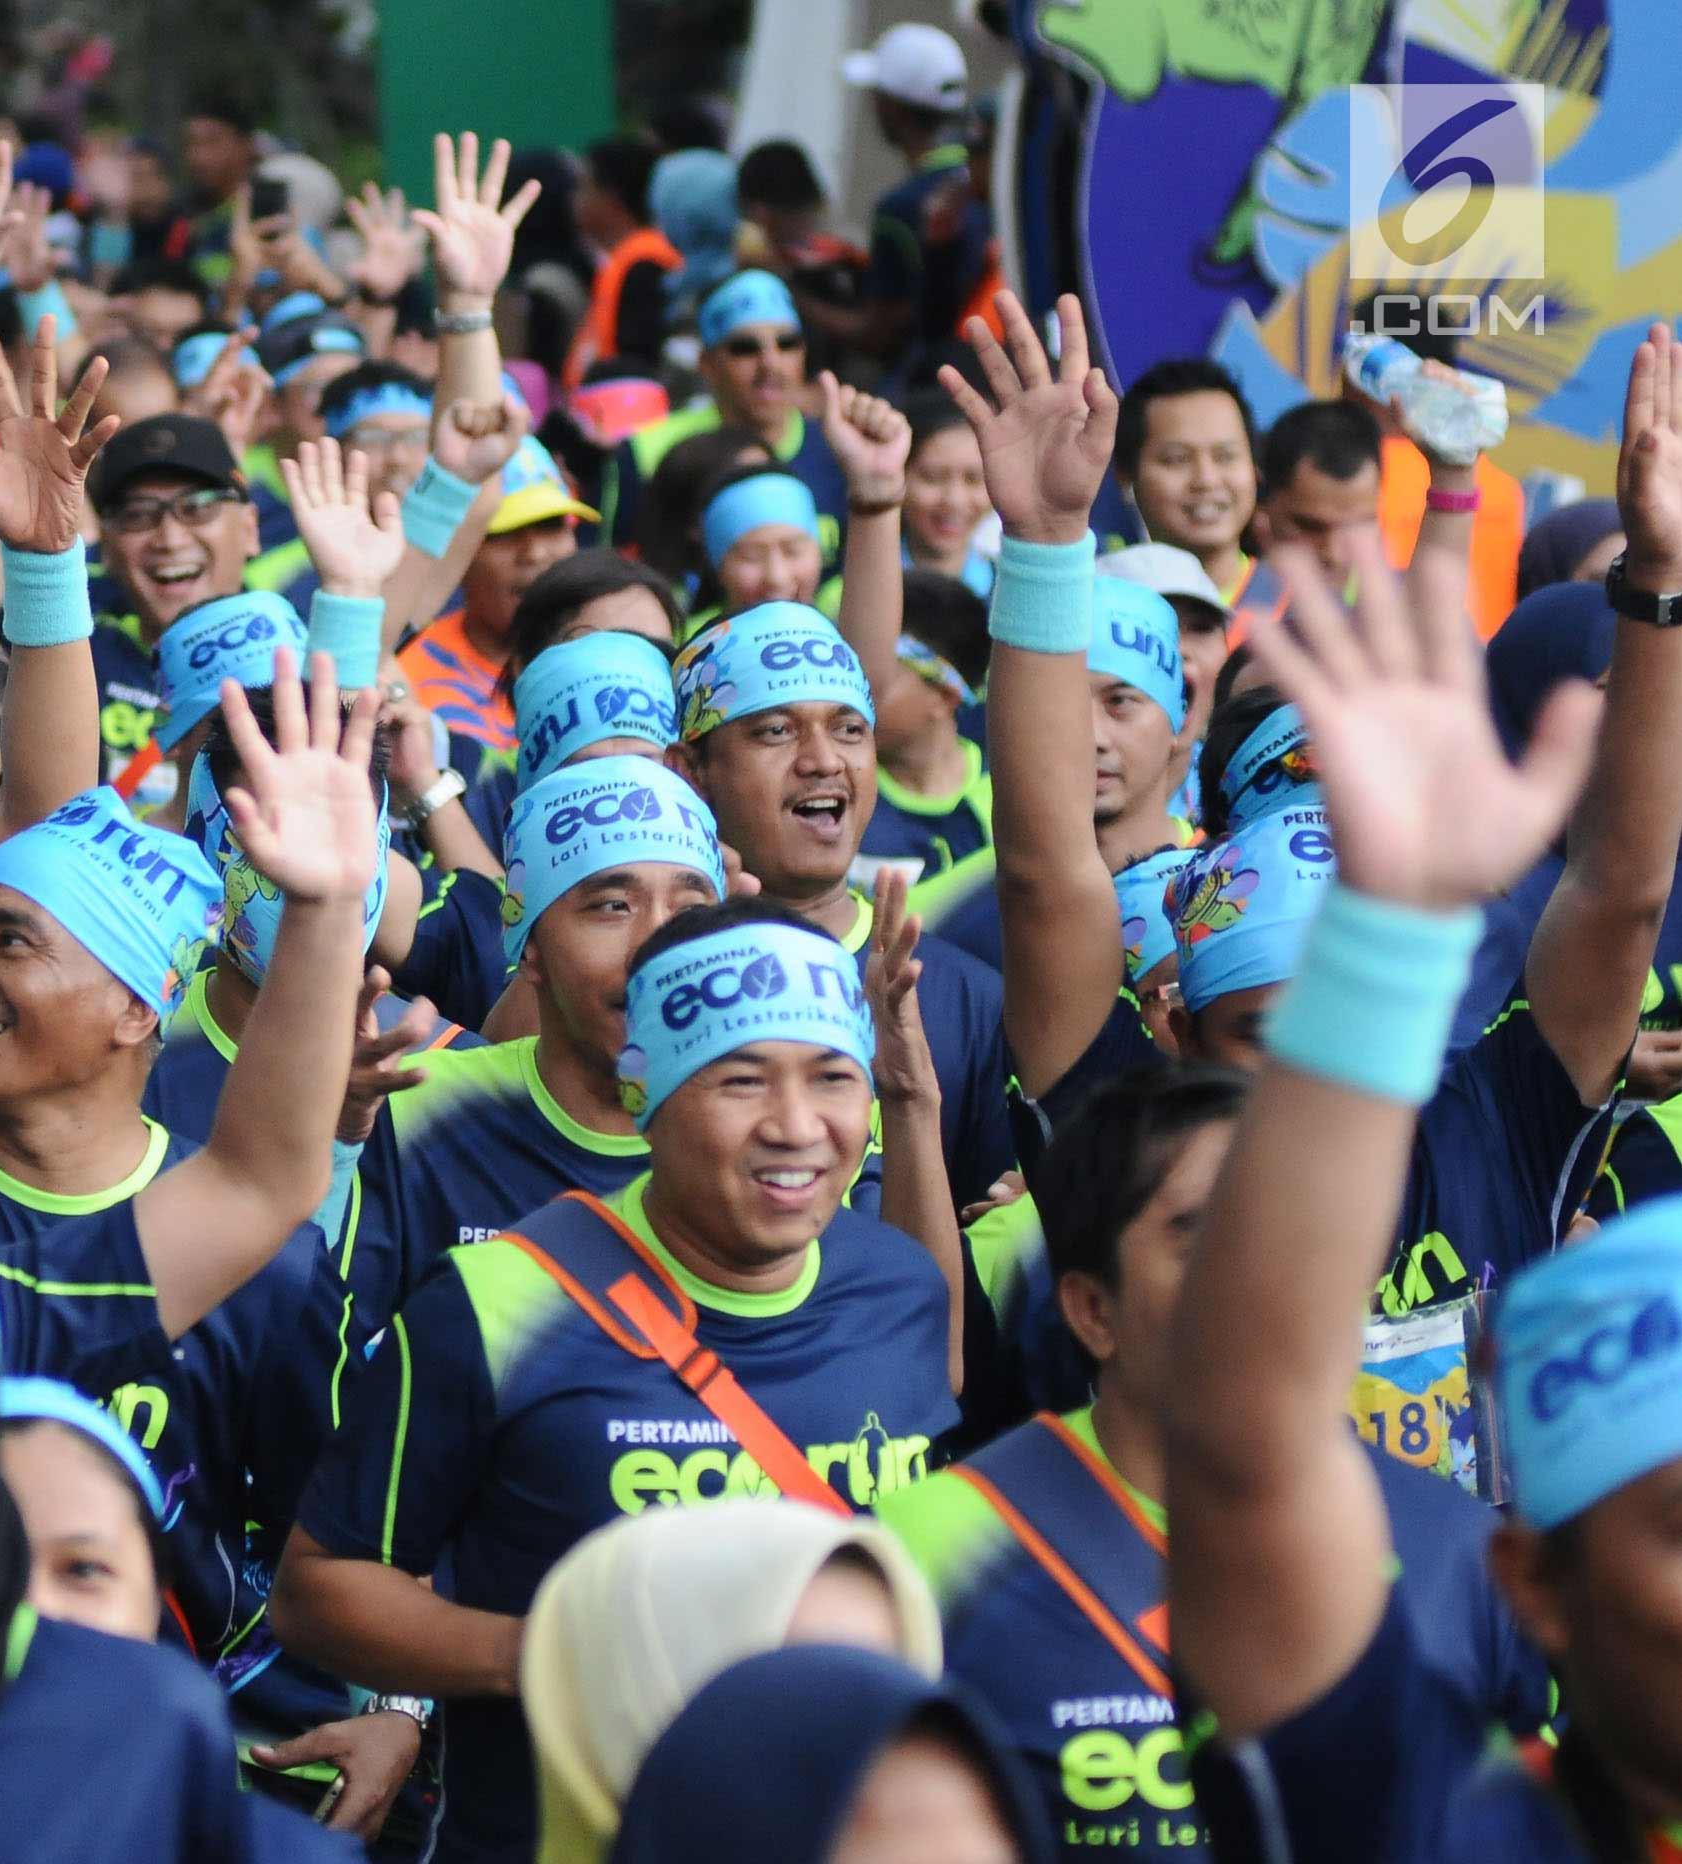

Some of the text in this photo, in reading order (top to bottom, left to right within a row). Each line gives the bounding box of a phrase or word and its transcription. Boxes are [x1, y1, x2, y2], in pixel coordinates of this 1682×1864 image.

[544, 781, 640, 812] PERTAMINA
[545, 787, 663, 845] eco
[91, 819, 187, 907] run
[551, 838, 588, 869] Lari
[122, 874, 164, 922] Bumi
[656, 946, 761, 990] PERTAMINA
[661, 953, 788, 1031] eco
[607, 1418, 739, 1444] PERTAMIN
[1052, 1695, 1175, 1728] PERTAM
[1059, 1725, 1195, 1811] ec
[1065, 1817, 1140, 1846] Lari
